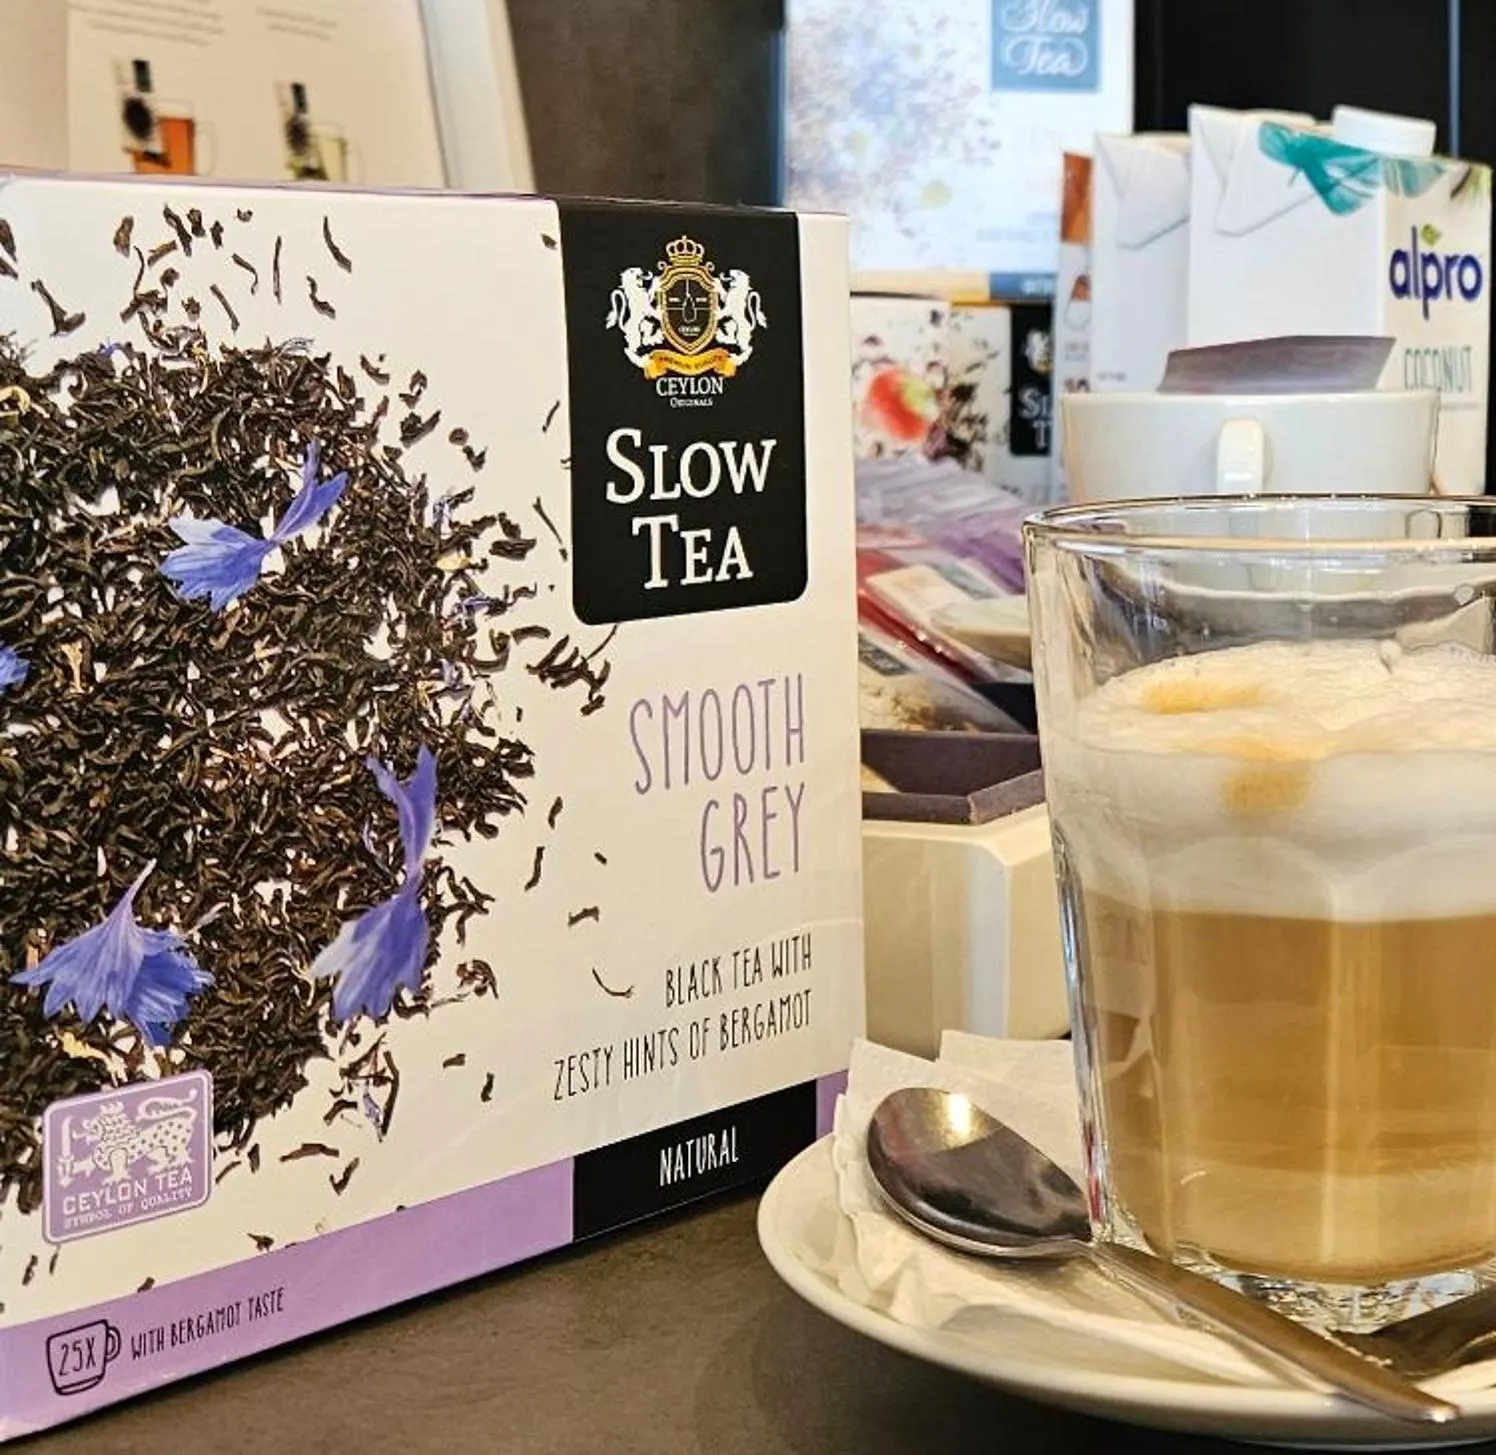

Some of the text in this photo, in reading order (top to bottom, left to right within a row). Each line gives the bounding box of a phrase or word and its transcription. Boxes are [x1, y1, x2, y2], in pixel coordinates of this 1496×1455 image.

[1004, 33, 1089, 77] Tea
[1390, 225, 1483, 321] alpro
[656, 377, 724, 396] CEYLON
[1404, 346, 1473, 393] COCONUT
[606, 428, 777, 504] SLOW
[632, 514, 754, 589] TEA
[630, 673, 804, 795] SMOOTH
[700, 782, 805, 892] GREY
[665, 933, 812, 1008] BLACK TEA WITH
[553, 989, 812, 1101] ZESTY HINTS OF BERGAMOT
[62, 1166, 193, 1216] CEYLON TEA
[659, 1126, 740, 1187] NATURAL
[58, 1336, 97, 1376] 25X
[130, 1287, 285, 1360] WITH BERGAMOT TASTE
